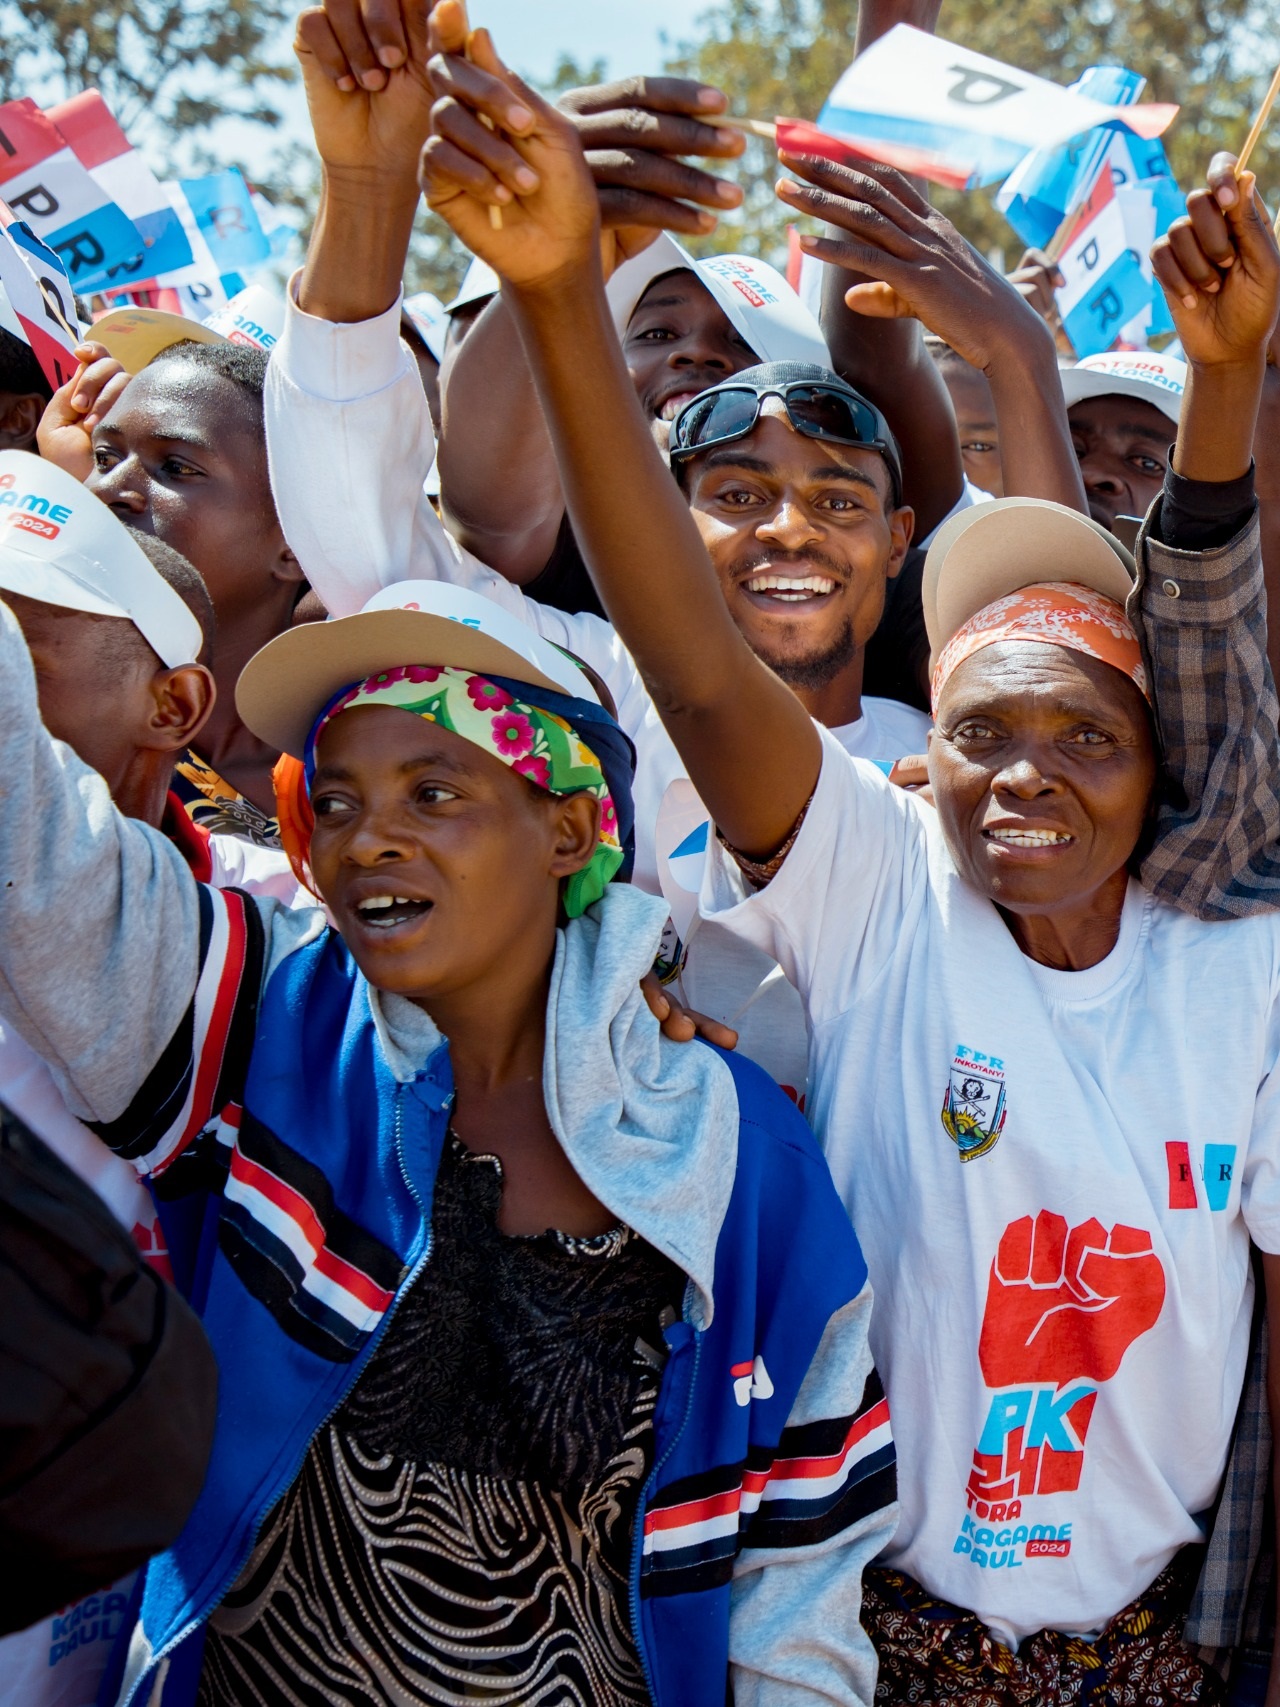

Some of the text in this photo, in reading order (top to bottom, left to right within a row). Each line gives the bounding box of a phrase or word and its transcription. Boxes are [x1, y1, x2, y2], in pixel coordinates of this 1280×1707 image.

[954, 1044, 1004, 1070] FPR
[954, 1057, 1004, 1078] INKOTANYI
[965, 1487, 1022, 1523] TORA
[961, 1514, 1073, 1548] KAGAME
[953, 1535, 1067, 1569] PAUL 2024
